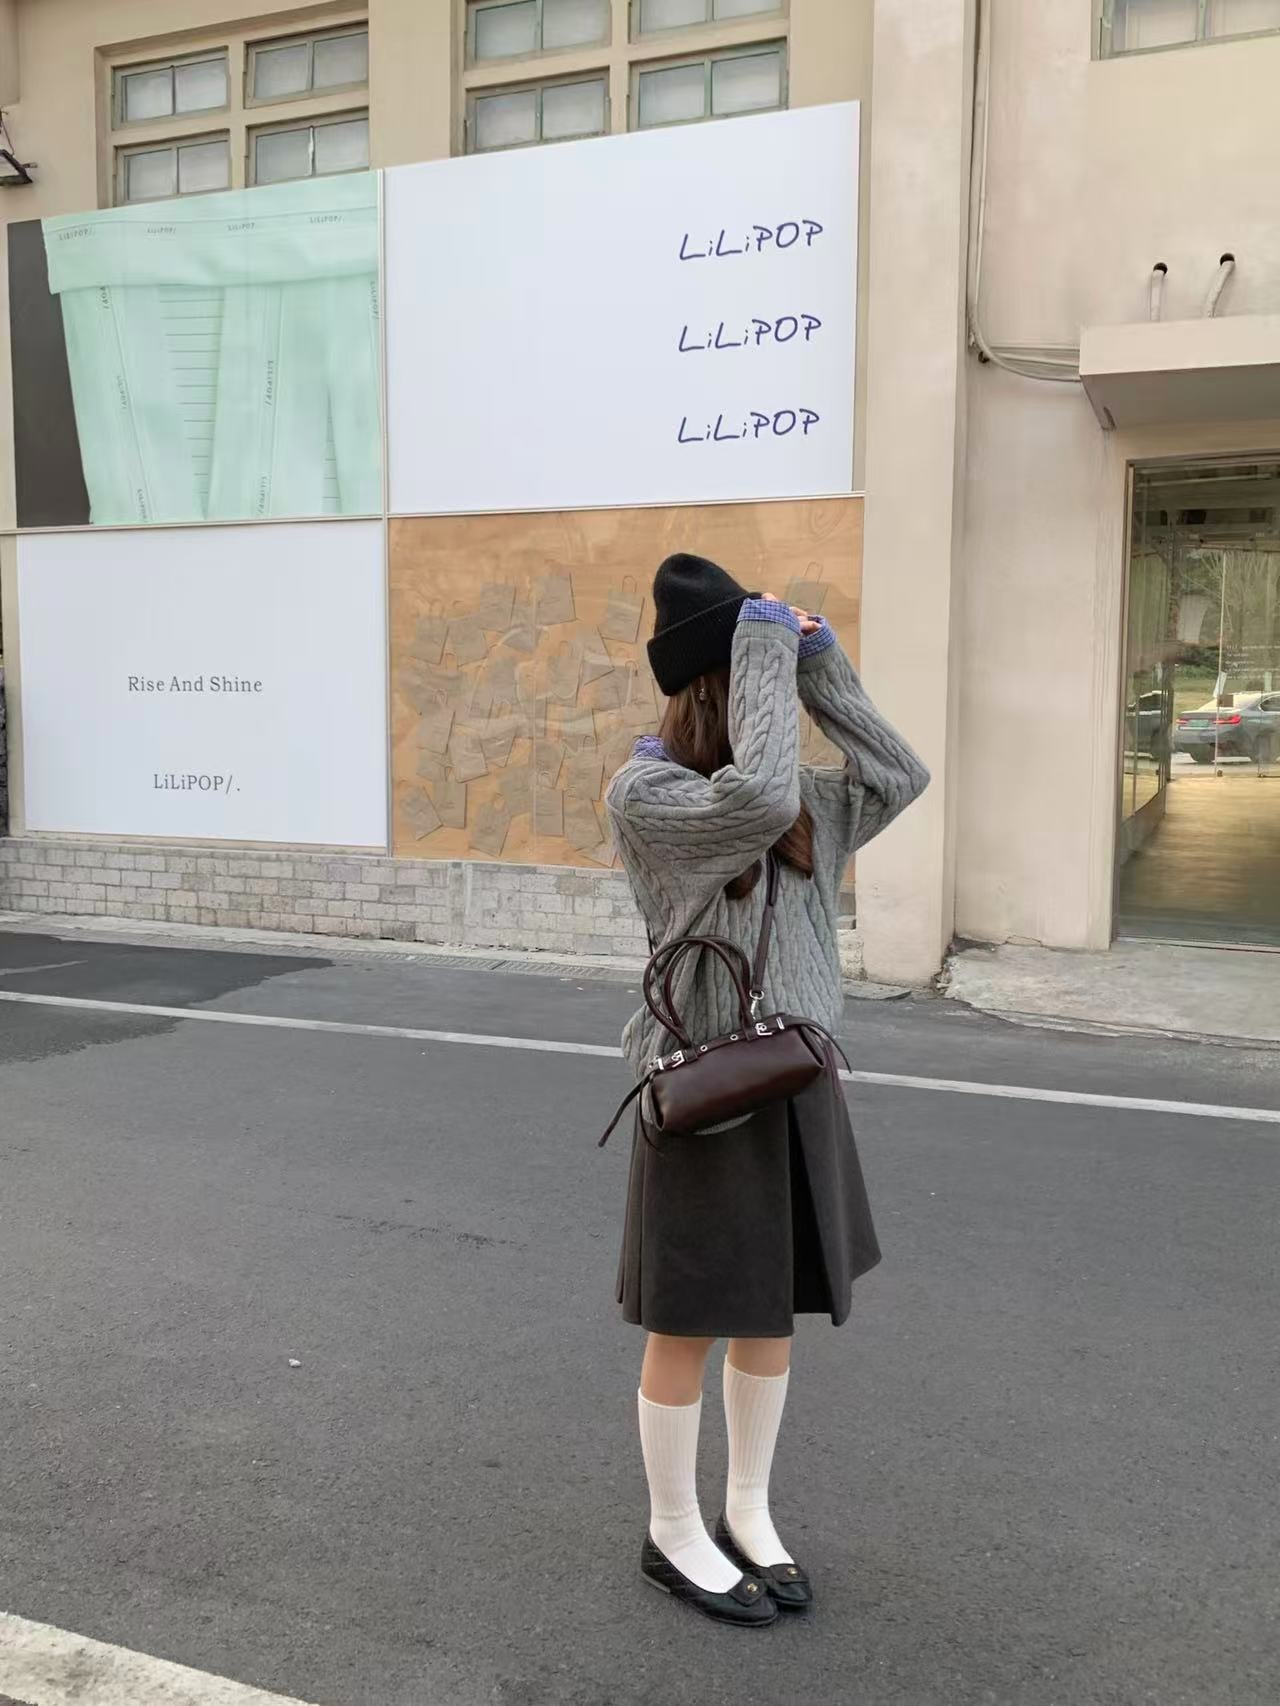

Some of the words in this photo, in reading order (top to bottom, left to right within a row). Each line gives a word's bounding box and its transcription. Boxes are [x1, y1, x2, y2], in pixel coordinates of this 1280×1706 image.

[680, 220, 823, 260] LiLiPOP
[679, 314, 821, 352] LiLiPOP
[678, 408, 820, 443] LiLiPOP
[128, 676, 165, 692] Rise
[169, 675, 204, 692] And
[209, 676, 263, 692] Shine
